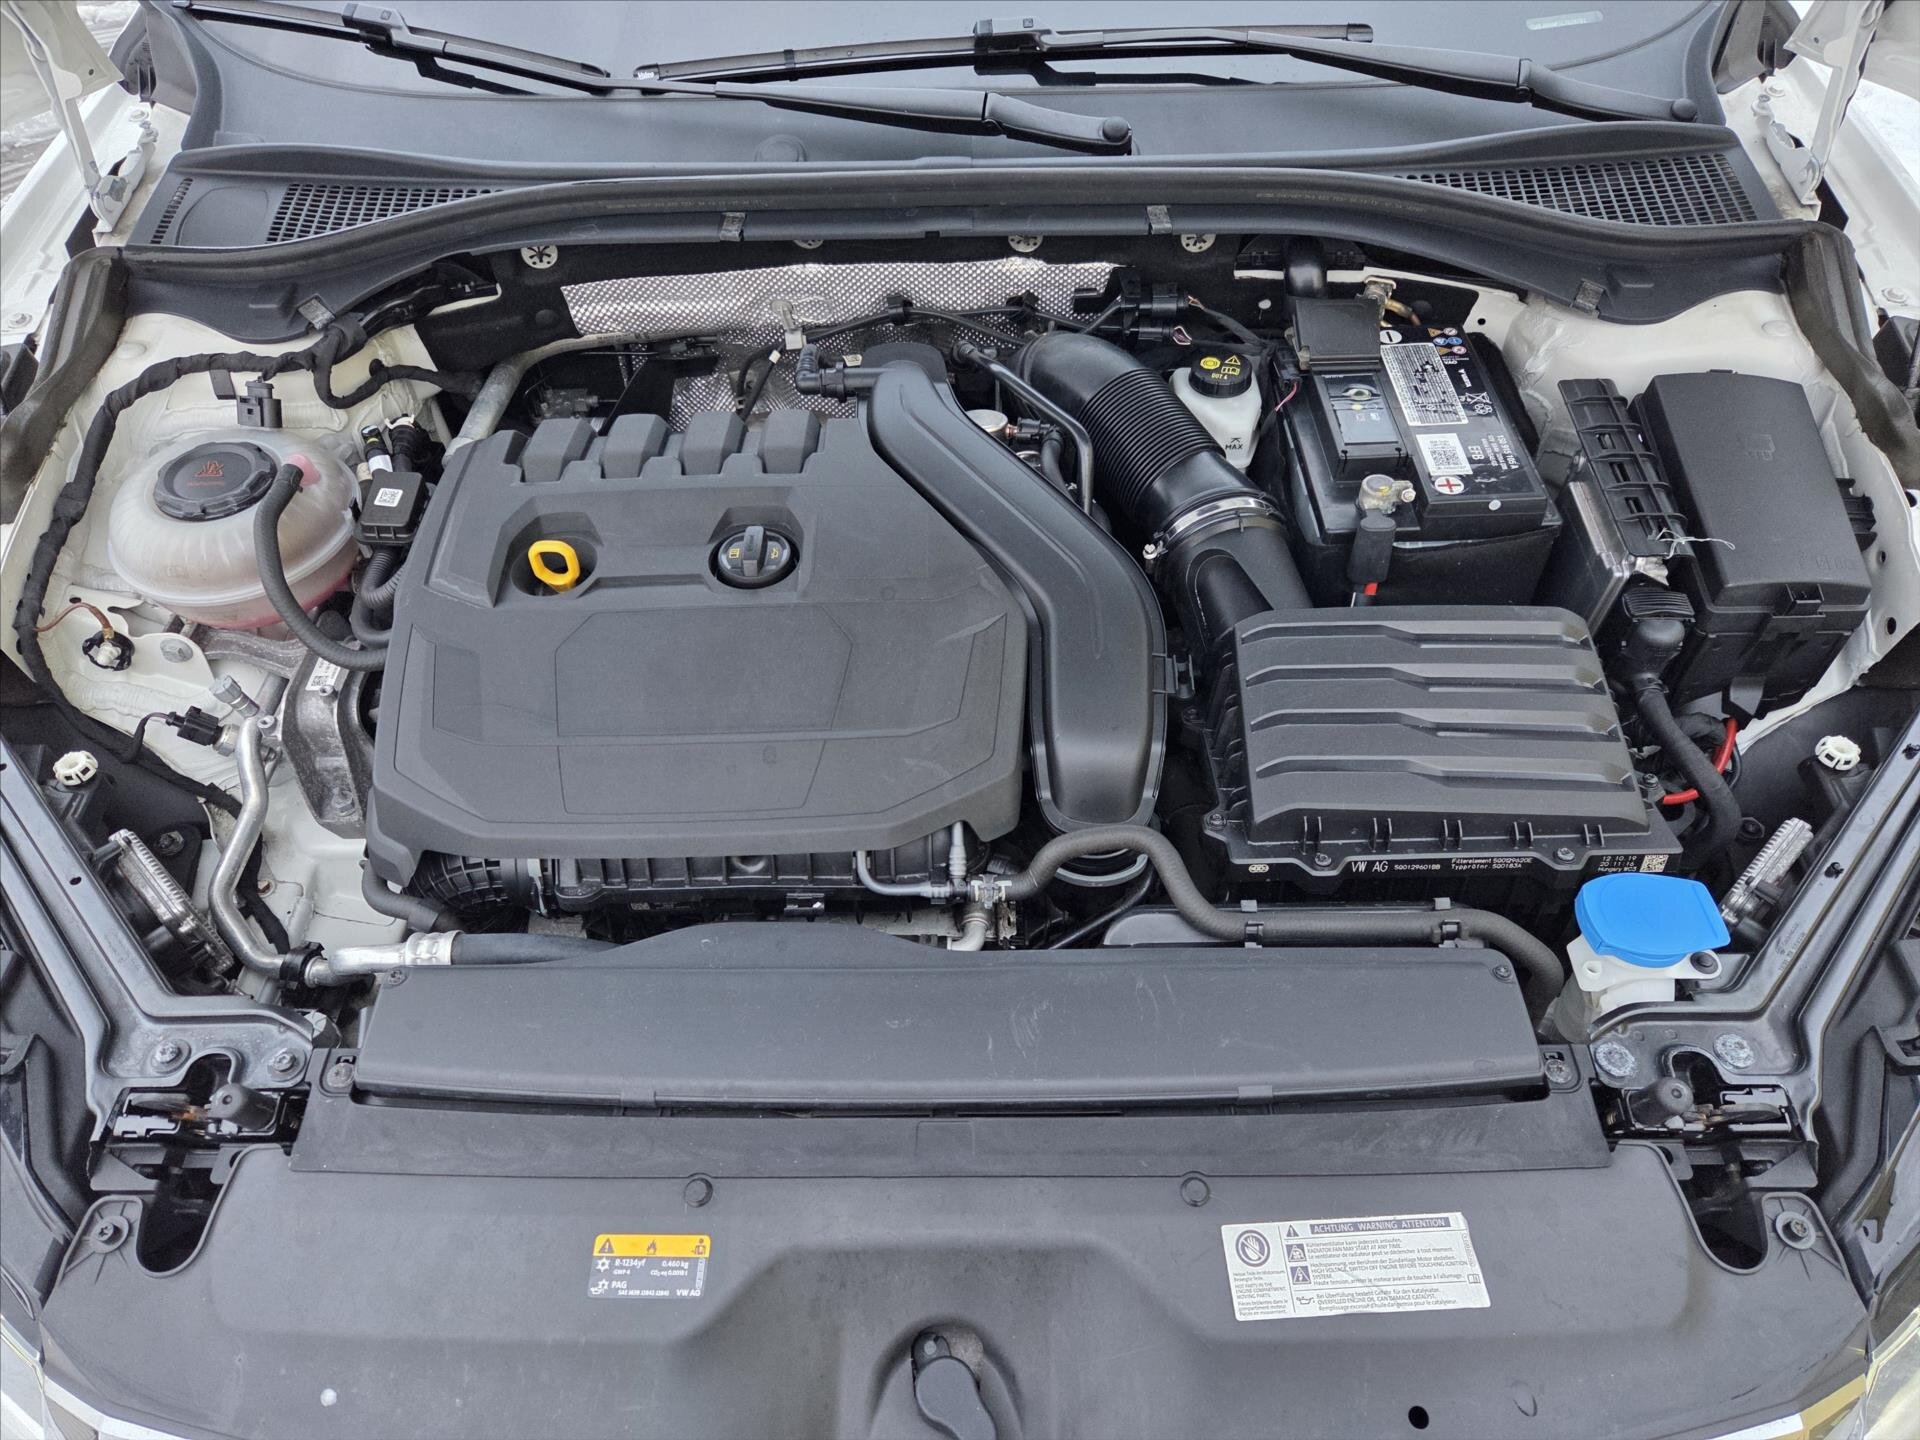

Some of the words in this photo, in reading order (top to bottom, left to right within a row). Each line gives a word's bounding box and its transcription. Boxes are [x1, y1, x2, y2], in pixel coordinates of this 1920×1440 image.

[1468, 445, 1485, 460] EFB
[1351, 860, 1368, 872] VW
[1372, 860, 1389, 872] AG
[1314, 1223, 1353, 1233] ACHTUNG
[1357, 1220, 1398, 1230] WARNING
[1401, 1218, 1446, 1228] ATTENTION
[615, 1258, 646, 1269] R-1234yf
[611, 1280, 628, 1289] PAG
